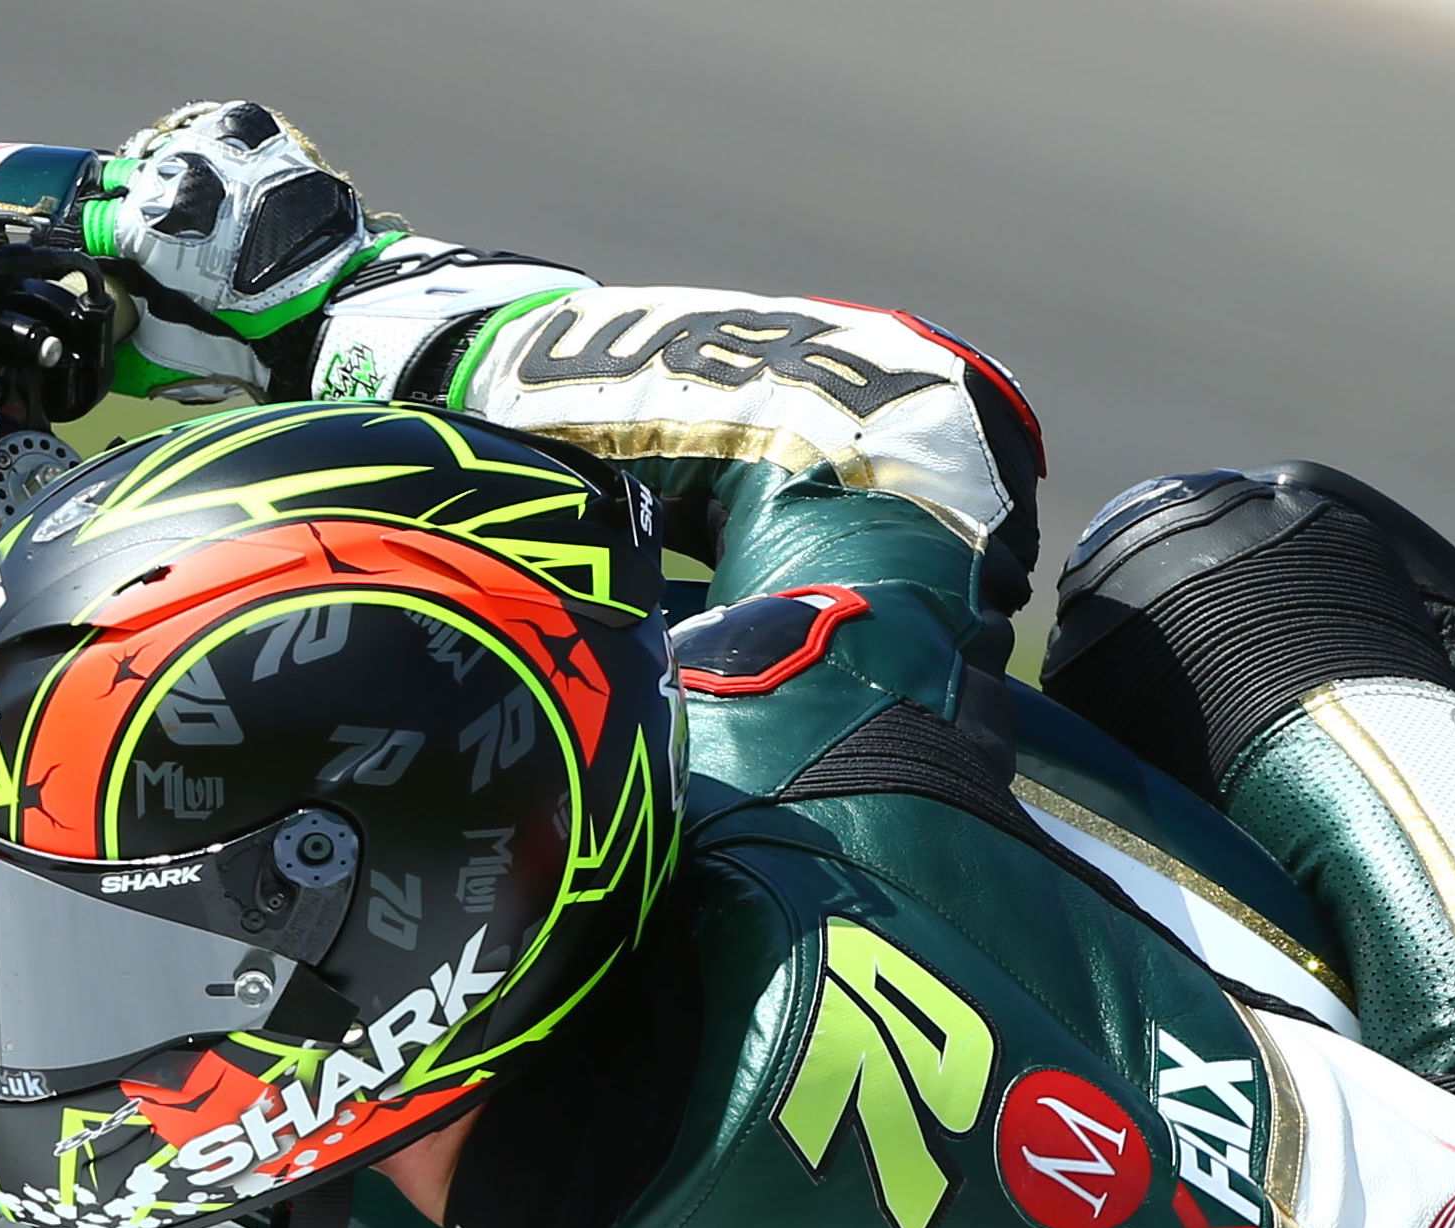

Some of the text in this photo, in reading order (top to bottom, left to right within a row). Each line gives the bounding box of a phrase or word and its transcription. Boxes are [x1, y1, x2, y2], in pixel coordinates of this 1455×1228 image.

[314, 725, 426, 786] 70
[100, 864, 204, 895] SHARK
[172, 922, 507, 1187] SHARK
